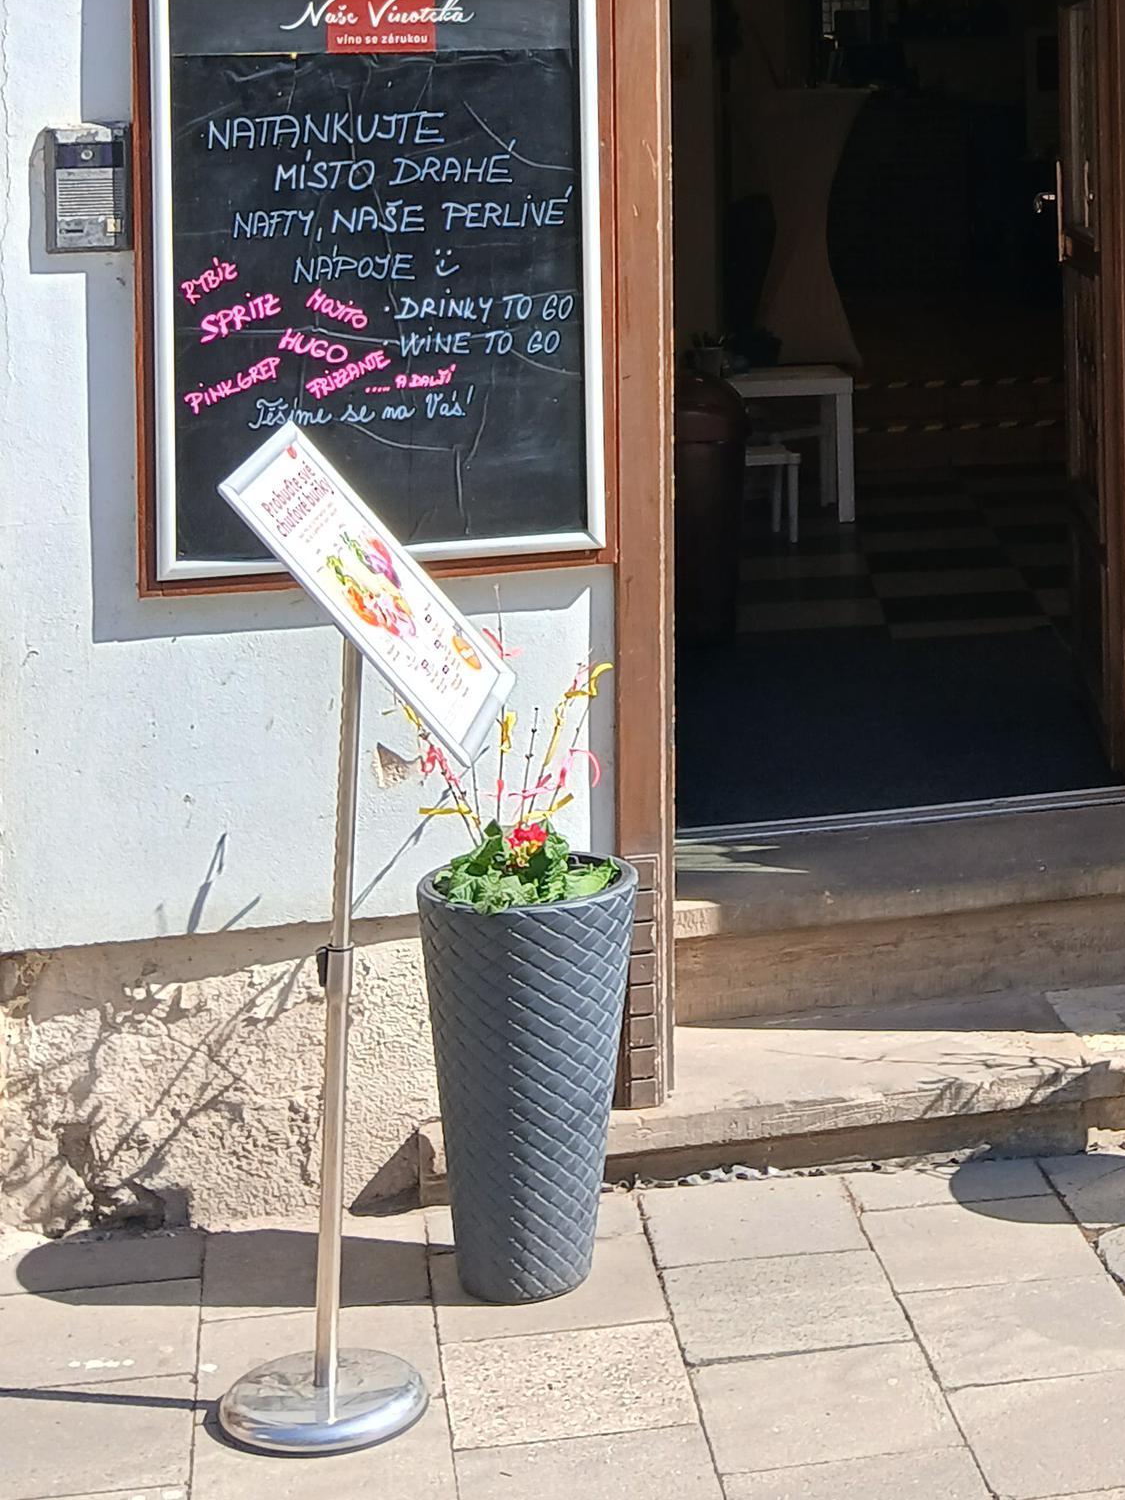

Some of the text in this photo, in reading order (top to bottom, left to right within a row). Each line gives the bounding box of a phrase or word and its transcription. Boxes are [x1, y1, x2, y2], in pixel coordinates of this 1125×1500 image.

[336, 33, 428, 45] víno se zárukou
[208, 110, 445, 150] NATANKUJTE
[274, 139, 517, 191] MÍSTO DRAHÉ
[233, 185, 573, 242] NAFTY, NAŠE PERLIVÉ
[293, 244, 415, 283] NÁPOJE
[200, 292, 282, 343] SPRITZ
[394, 288, 574, 323] DRINKY TO GO
[278, 328, 349, 364] HUGO
[399, 326, 560, 357] WINE TO GO
[341, 404, 375, 423] se
[382, 404, 417, 420] na
